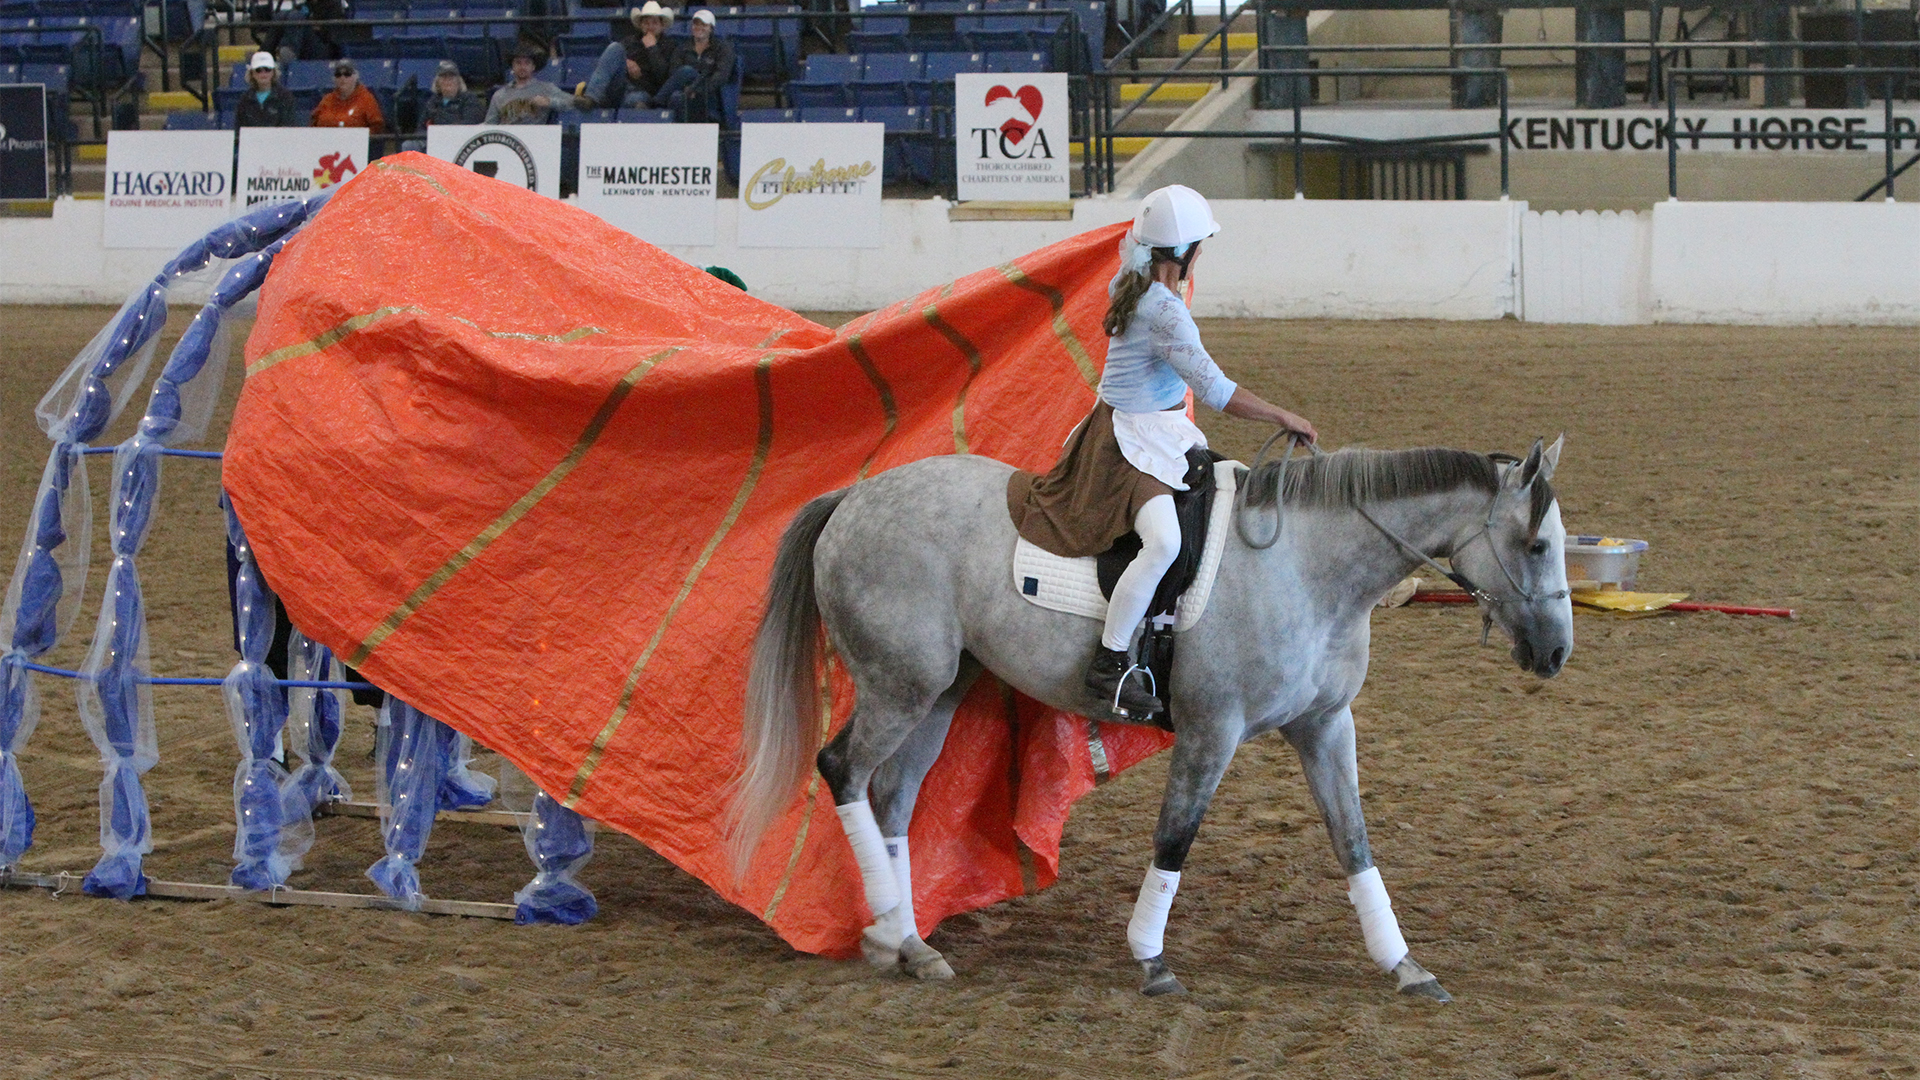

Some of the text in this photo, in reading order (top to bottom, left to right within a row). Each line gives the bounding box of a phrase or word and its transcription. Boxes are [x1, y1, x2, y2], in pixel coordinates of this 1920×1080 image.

[1499, 117, 1708, 150] KENTUCKY
[1733, 117, 1868, 150] HORSE
[971, 128, 1055, 159] TCA
[586, 165, 712, 185] THE MANCHESTER
[976, 162, 1052, 172] THOROUGHBRED
[111, 170, 225, 196] HAGYARD
[247, 176, 310, 192] MARYLAND
[961, 174, 1065, 184] CHARITIES OF AMERICA
[602, 187, 711, 197] LEXINGTON KENTUCKY
[109, 198, 224, 208] EQUINE MEDICAL INSTITUTE
